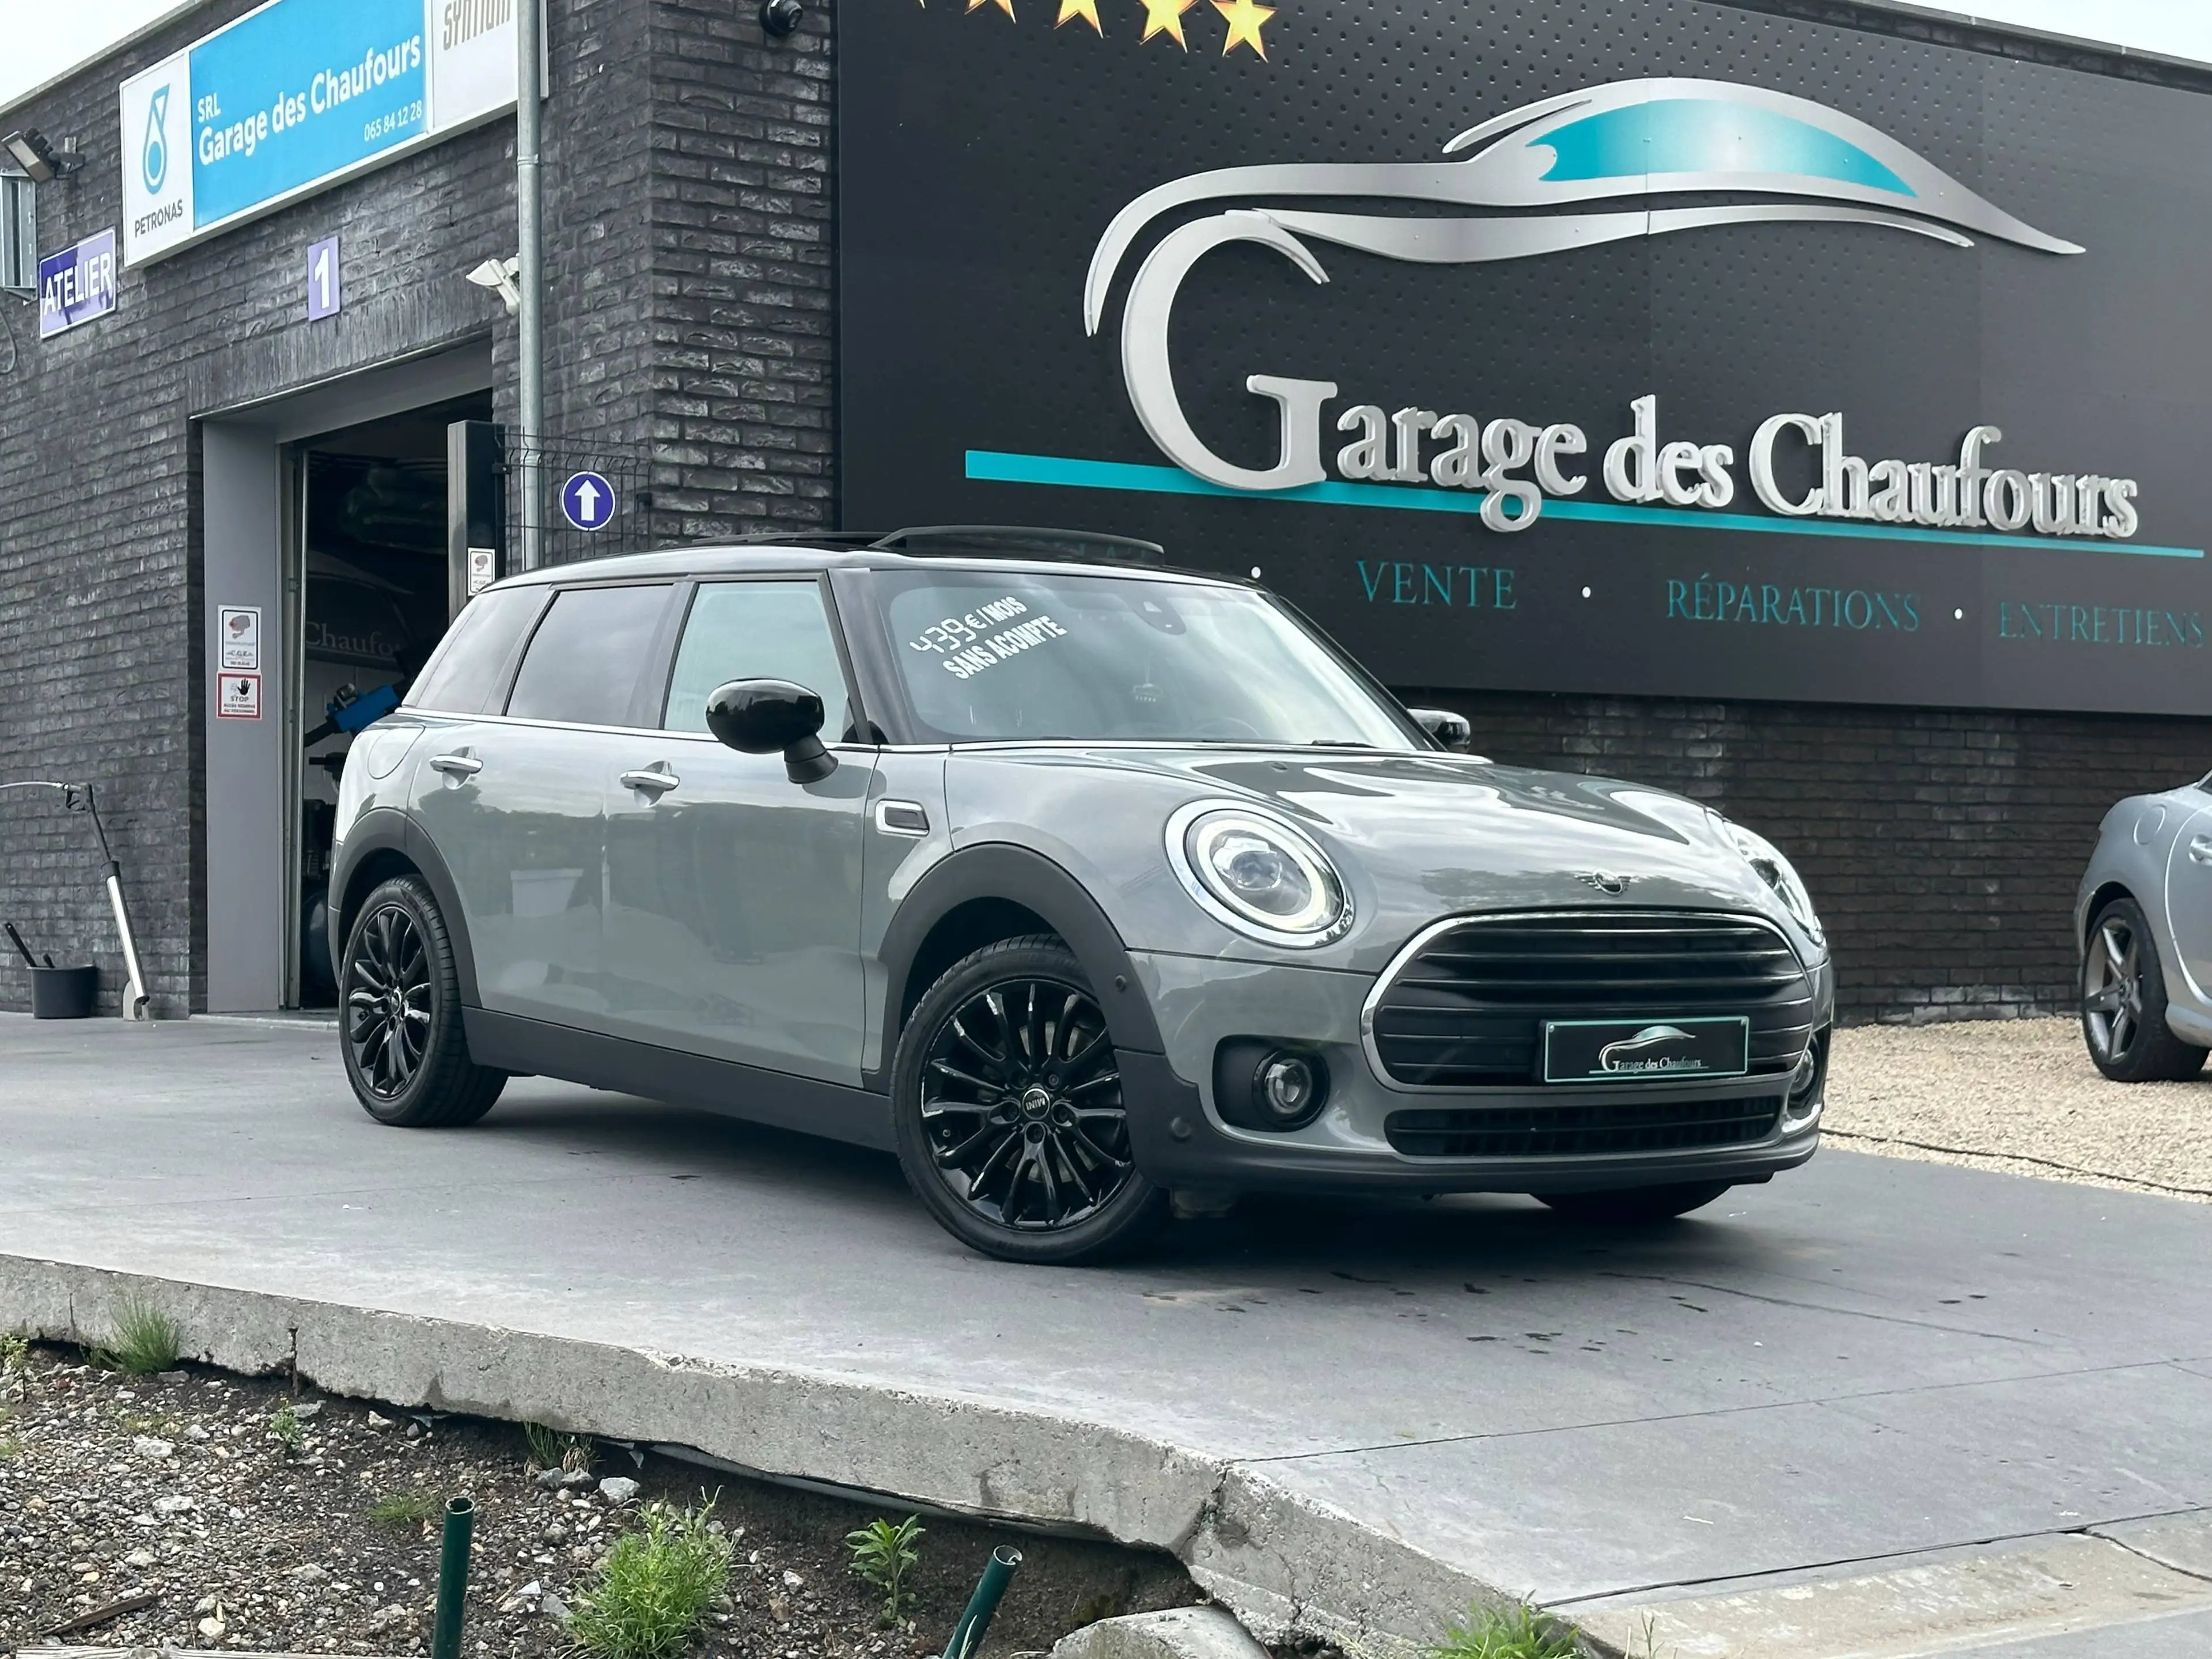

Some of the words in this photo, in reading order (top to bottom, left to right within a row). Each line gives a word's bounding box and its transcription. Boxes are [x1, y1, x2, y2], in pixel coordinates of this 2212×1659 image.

[198, 93, 221, 123] SRL
[199, 110, 268, 165] Garage
[272, 92, 306, 134] des
[310, 35, 421, 114] Chaufours
[363, 119, 381, 142] 065
[384, 116, 395, 134] 84
[397, 107, 408, 131] 12
[410, 100, 422, 119] 28
[135, 199, 183, 238] PETRONAS
[44, 252, 112, 316] ATELIER
[315, 248, 329, 309] 1
[1121, 209, 1586, 533] Garage
[1603, 394, 1734, 508] des
[1748, 411, 2138, 539] Chaufours
[1355, 560, 1517, 609] VENTE
[1666, 572, 1920, 632] RÉPARATIONS
[1999, 601, 2205, 649] ENTRETIENS
[942, 645, 998, 679] SANS
[984, 615, 1067, 659] ACOMPTE
[1645, 1058, 1658, 1070] des
[1025, 1097, 1046, 1111] MINI
